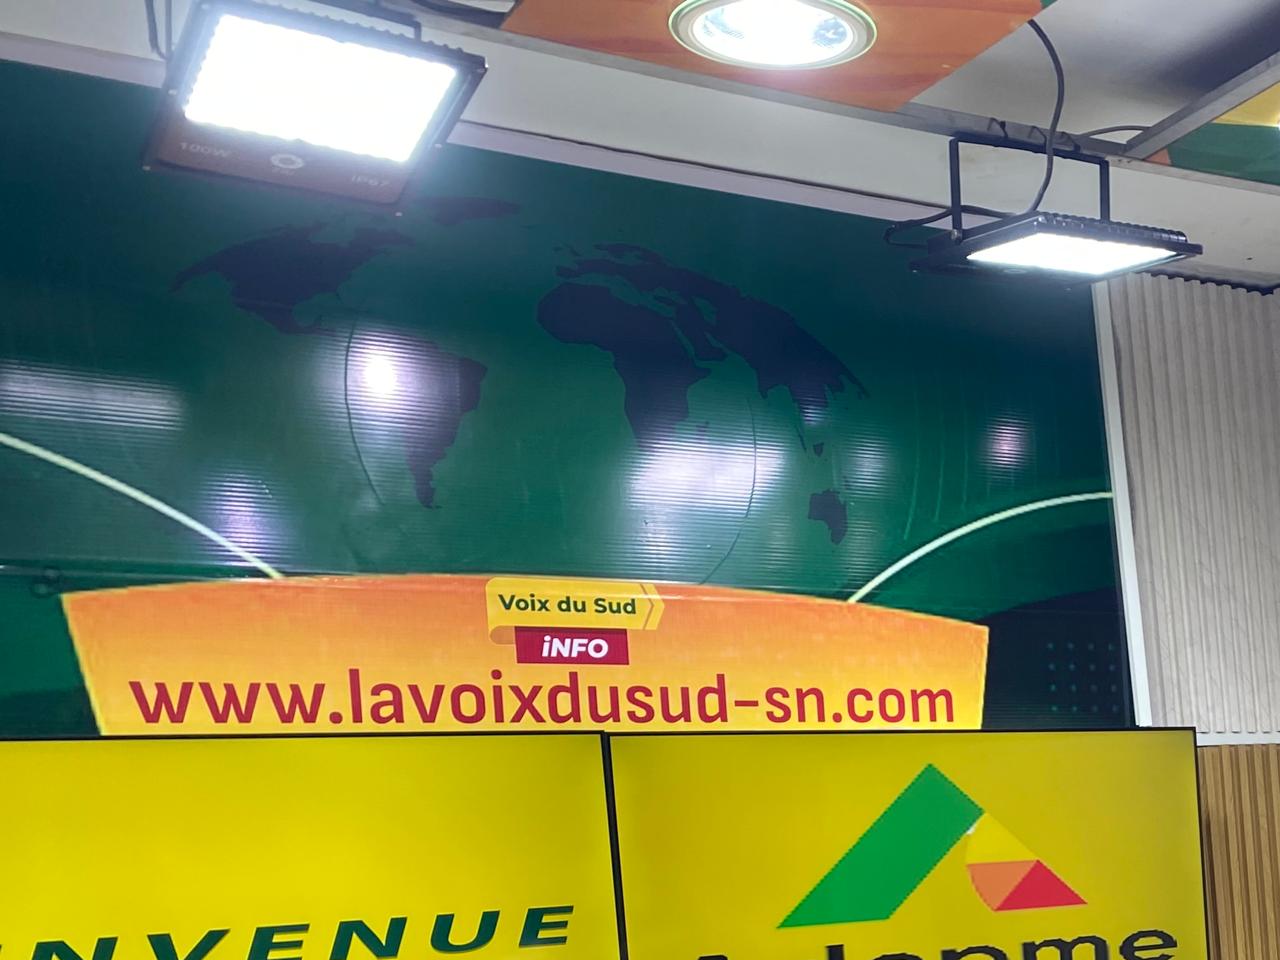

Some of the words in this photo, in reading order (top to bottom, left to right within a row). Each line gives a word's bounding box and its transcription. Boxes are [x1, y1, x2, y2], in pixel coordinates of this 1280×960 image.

[498, 593, 550, 612] Voix
[557, 596, 586, 613] du
[594, 597, 636, 614] Sud
[541, 635, 609, 658] iNFO
[128, 668, 955, 724] www.lavoixdusud-sn.com
